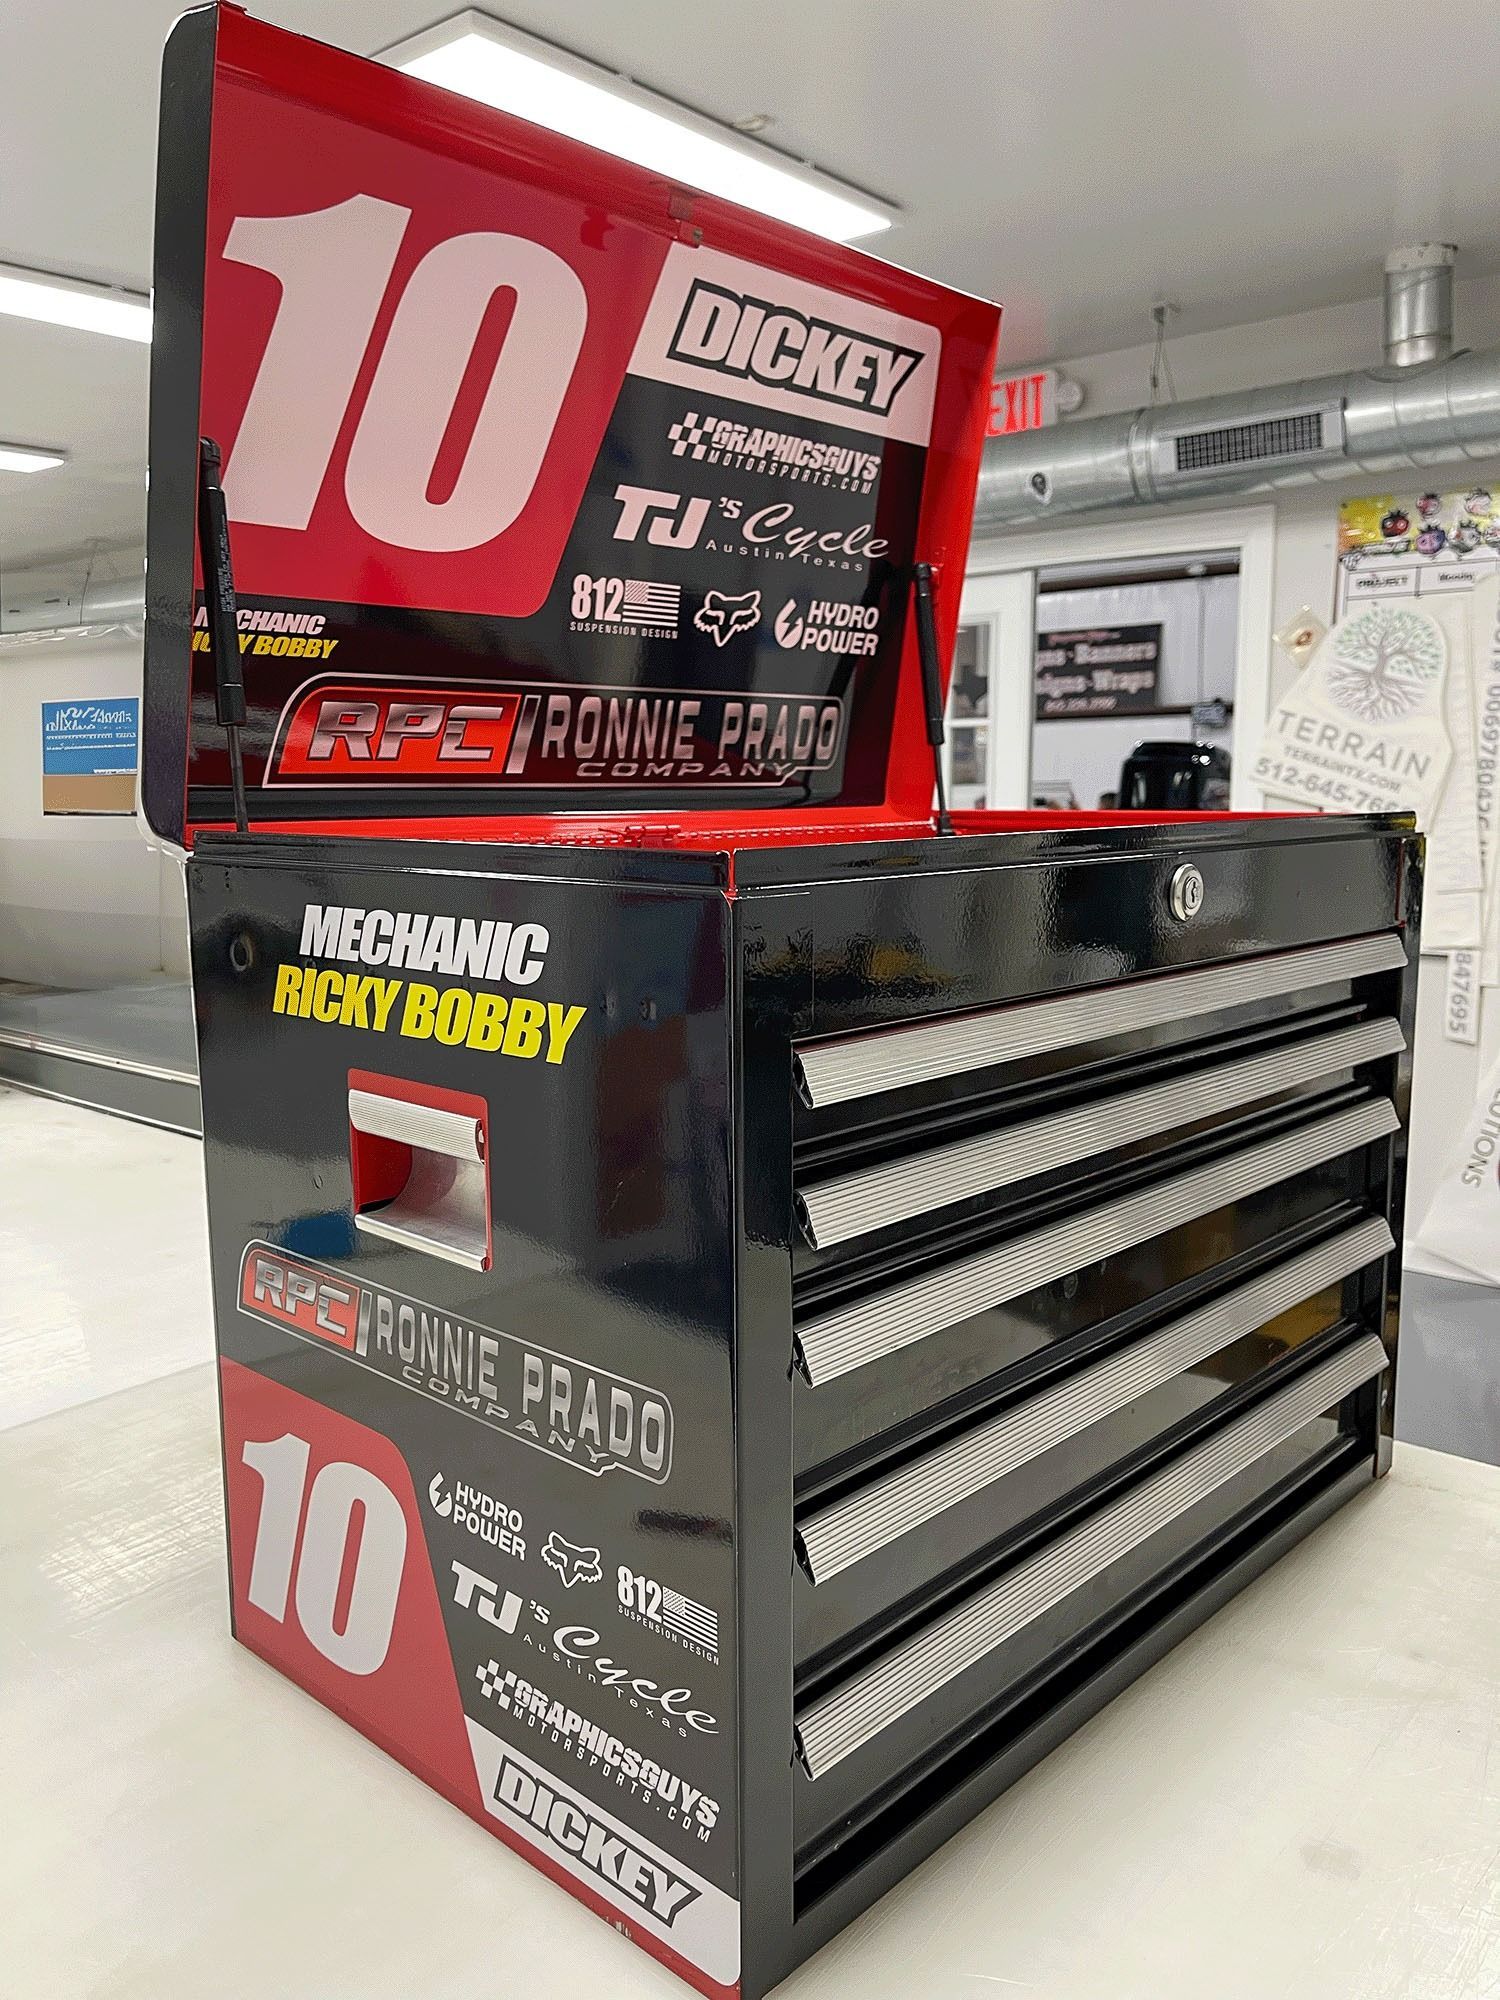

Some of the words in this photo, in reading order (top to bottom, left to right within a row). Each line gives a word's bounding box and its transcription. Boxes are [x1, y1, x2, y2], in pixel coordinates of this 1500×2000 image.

[222, 193, 588, 552] 10
[670, 282, 920, 414] DICKEY
[986, 373, 1045, 436] EXIT
[707, 452, 873, 495] MOTORSPORTS.COM
[712, 420, 882, 481] GRAPHICSGUYS
[705, 539, 784, 561] Austin
[801, 553, 864, 573] Texas
[742, 503, 889, 558] Cycle
[193, 606, 326, 635] MCHANIC
[570, 574, 626, 622] 812
[807, 600, 881, 630] HYDRO
[252, 636, 339, 660] BOBBY
[569, 621, 637, 637] SUSPENSION
[641, 626, 679, 640] DESIGN
[801, 628, 880, 657] POWER
[308, 701, 504, 760] RPC
[541, 695, 702, 761] RONNIE
[718, 702, 840, 761] PRADO
[1277, 709, 1432, 780] TERRAIN
[577, 762, 793, 777] COMPANY
[1255, 757, 1411, 812] 512-645-76
[299, 904, 551, 986] MECHANIC
[272, 964, 403, 1033] RICKY
[400, 982, 588, 1065] BOBBY
[1449, 952, 1472, 1034] 847695
[253, 1259, 351, 1337] RPC
[376, 1293, 500, 1402] RONNIE
[522, 1352, 668, 1472] PRADO
[401, 1365, 610, 1465] COMPANY
[452, 1503, 527, 1561] POWER
[456, 1481, 524, 1534] HYDRO
[242, 1432, 408, 1676] 10
[617, 1565, 663, 1624] 812
[618, 1604, 678, 1644] SUSPENSION
[682, 1638, 720, 1666] DESIGN
[523, 1632, 597, 1684] Austin
[613, 1685, 688, 1738] Texas
[553, 1625, 720, 1734] Cycle
[513, 1705, 713, 1844] MOTORSPORTS.COM
[514, 1679, 722, 1830] GRAPHICSGUYS
[496, 1757, 698, 1925] DICKEY
